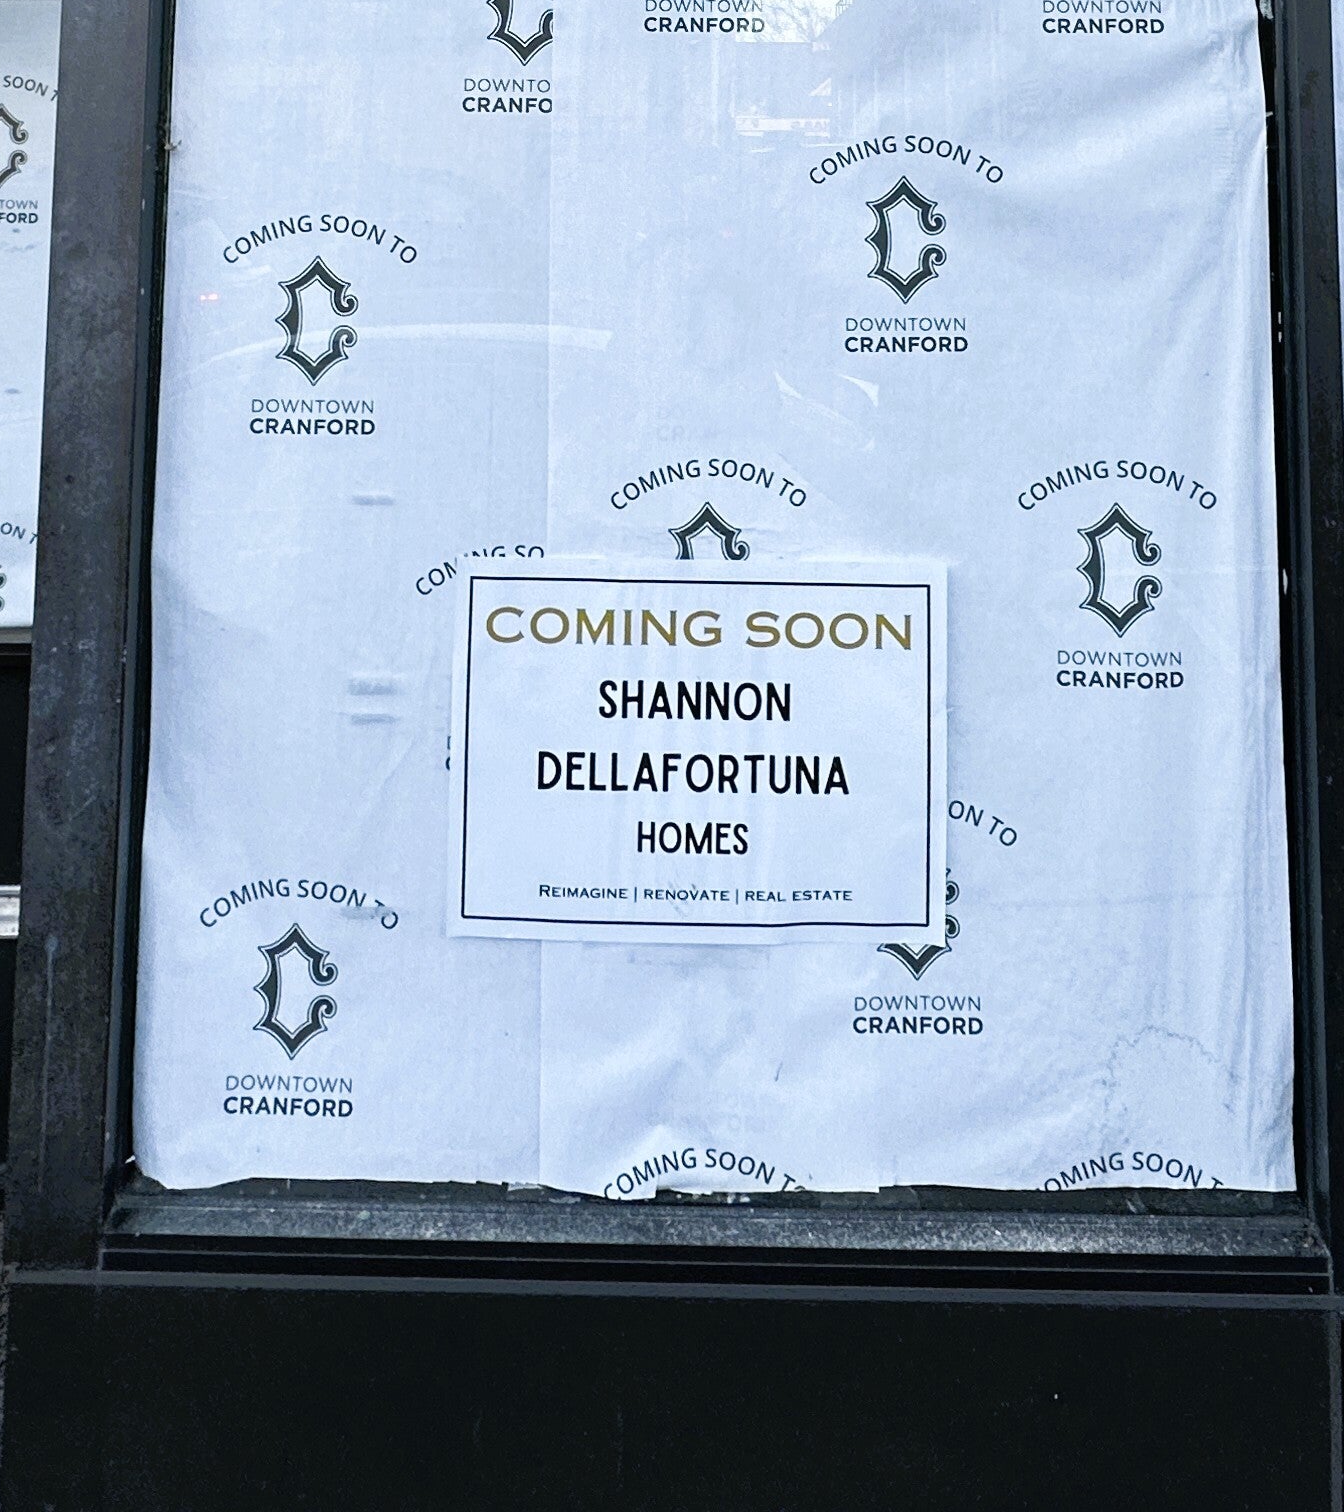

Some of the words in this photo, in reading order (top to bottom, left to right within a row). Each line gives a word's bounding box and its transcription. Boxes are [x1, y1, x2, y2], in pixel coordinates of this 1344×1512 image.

[1043, 0, 1162, 14] DOWNTOWN
[644, 17, 765, 34] CRANFORD
[1042, 18, 1165, 34] CRANFORD
[2, 75, 46, 96] SOON
[809, 136, 897, 184] COMING
[904, 135, 971, 165] SOON
[976, 155, 1004, 184] TO
[223, 215, 313, 265] COMING
[319, 214, 386, 245] SOON
[389, 236, 418, 265] TO
[846, 317, 966, 332] DOWNTOWN
[844, 336, 969, 353] CRANFORD
[251, 399, 375, 415] DOWNTOWN
[249, 418, 376, 435] CRANFORD
[610, 459, 701, 512] COMING
[708, 458, 774, 488] SOON
[778, 479, 807, 508] TO
[1017, 461, 1109, 512] COMING
[1116, 461, 1185, 491] SOON
[1188, 482, 1217, 511] TO
[486, 607, 722, 647] COMING
[745, 612, 912, 650] SOON
[1057, 650, 1182, 666] DOWNTOWN
[1056, 670, 1184, 689] CRANFORD
[598, 680, 791, 721] SHANNON
[537, 751, 849, 795] DELLAFORTUNA
[637, 822, 749, 855] HOMES
[987, 817, 1018, 847] TO
[199, 879, 291, 929] COMING
[297, 880, 367, 909] SOON
[368, 899, 399, 930] TO
[643, 889, 730, 901] RENOVATE
[745, 890, 786, 902] REAL
[792, 890, 853, 902] ESTATE
[855, 995, 981, 1011] DOWNTOWN
[853, 1016, 983, 1035] CRANFORD
[225, 1076, 353, 1093] DOWNTOWN
[223, 1097, 354, 1118] CRANFORD
[604, 1149, 697, 1201] COMING
[704, 1148, 775, 1183] SOON
[1131, 1150, 1202, 1186] SOON
